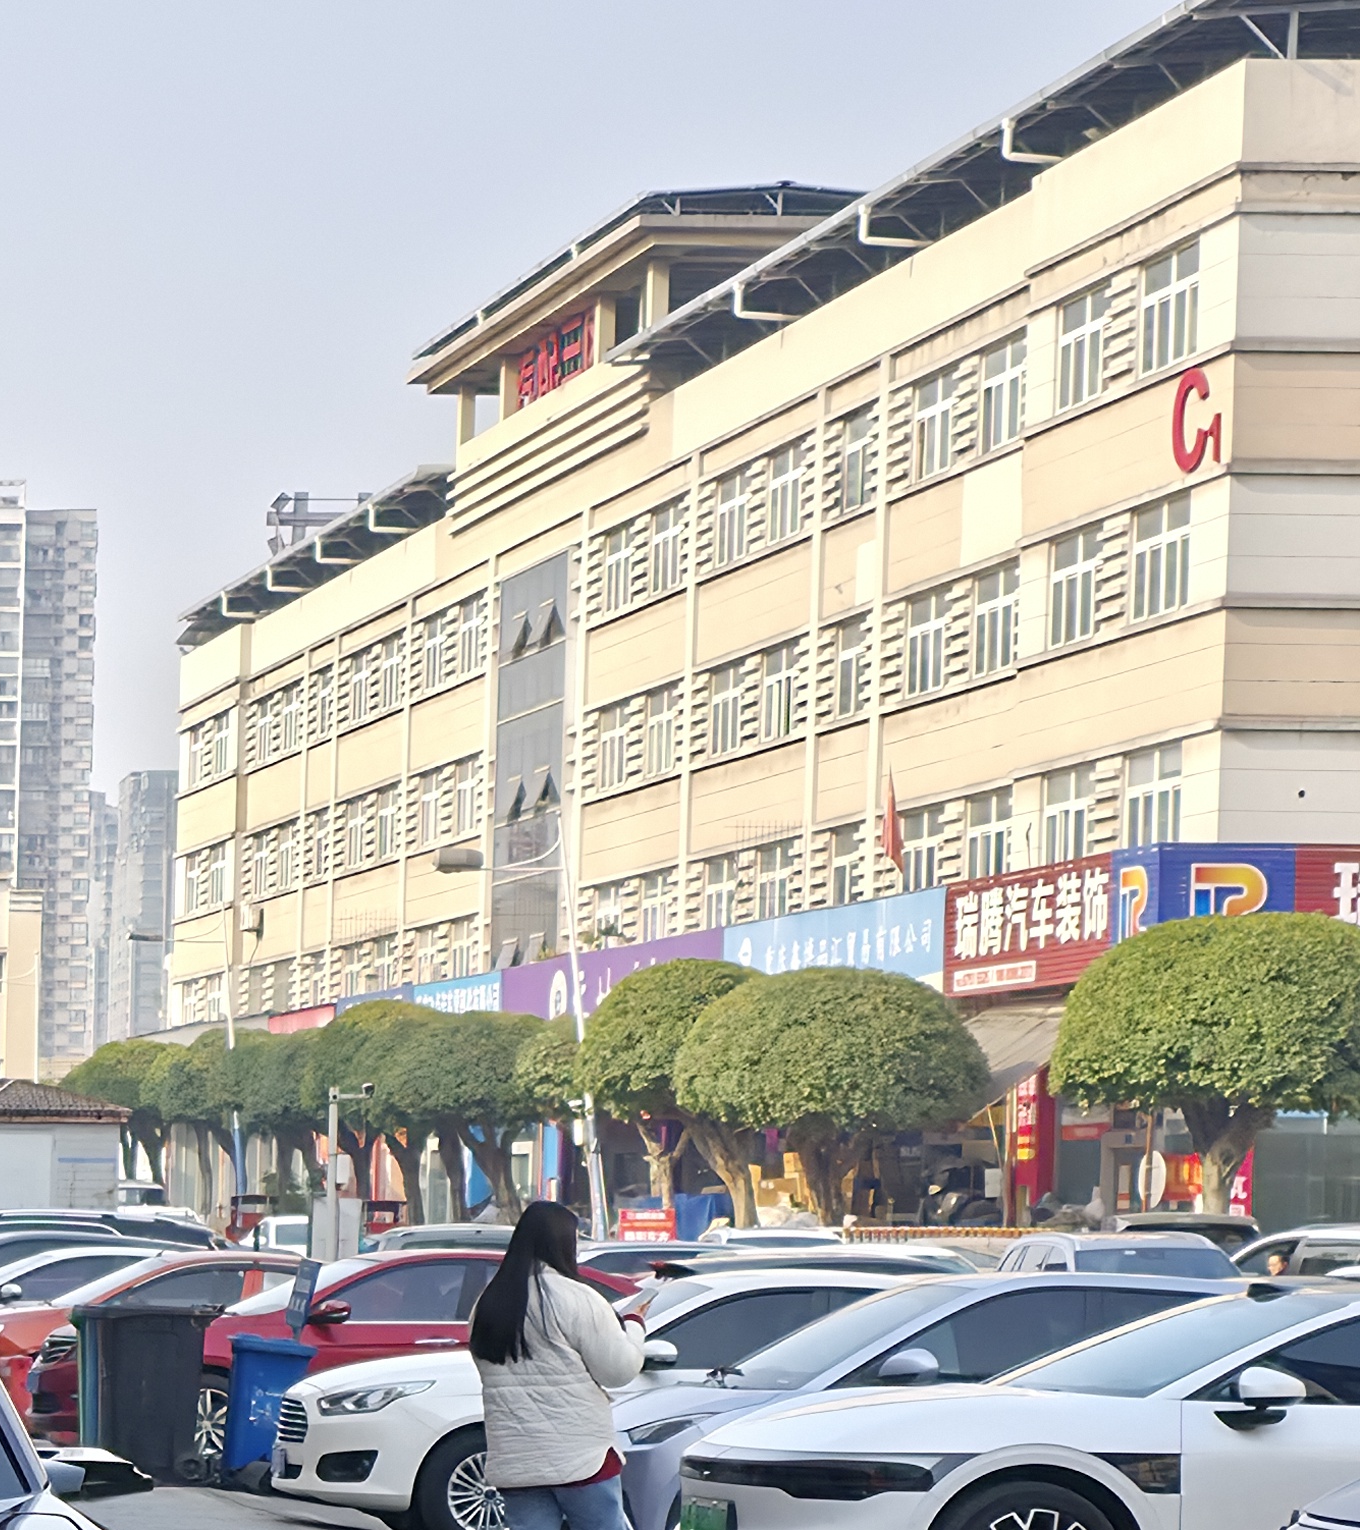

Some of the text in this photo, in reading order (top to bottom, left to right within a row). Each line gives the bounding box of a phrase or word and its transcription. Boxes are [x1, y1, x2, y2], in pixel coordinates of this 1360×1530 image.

[954, 867, 1110, 960] 瑞腾汽车装饰
